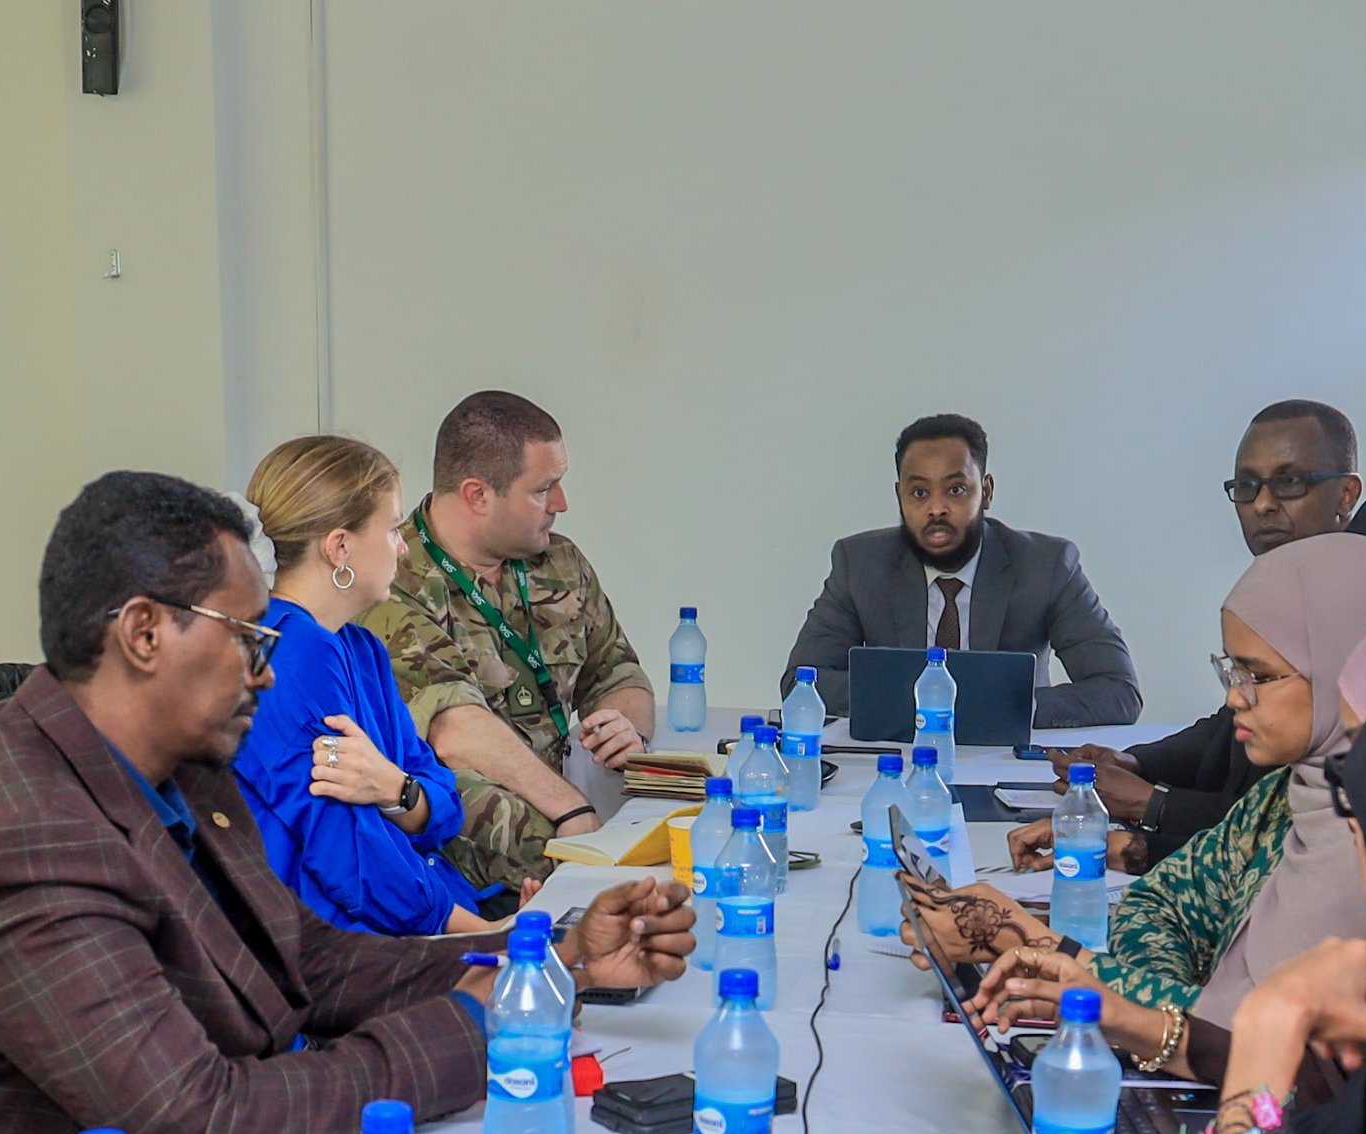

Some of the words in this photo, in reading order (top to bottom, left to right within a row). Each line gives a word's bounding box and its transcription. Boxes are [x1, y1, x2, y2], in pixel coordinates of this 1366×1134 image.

[441, 557, 457, 573] SKA
[471, 589, 486, 606] SKA
[499, 622, 514, 638] SKA
